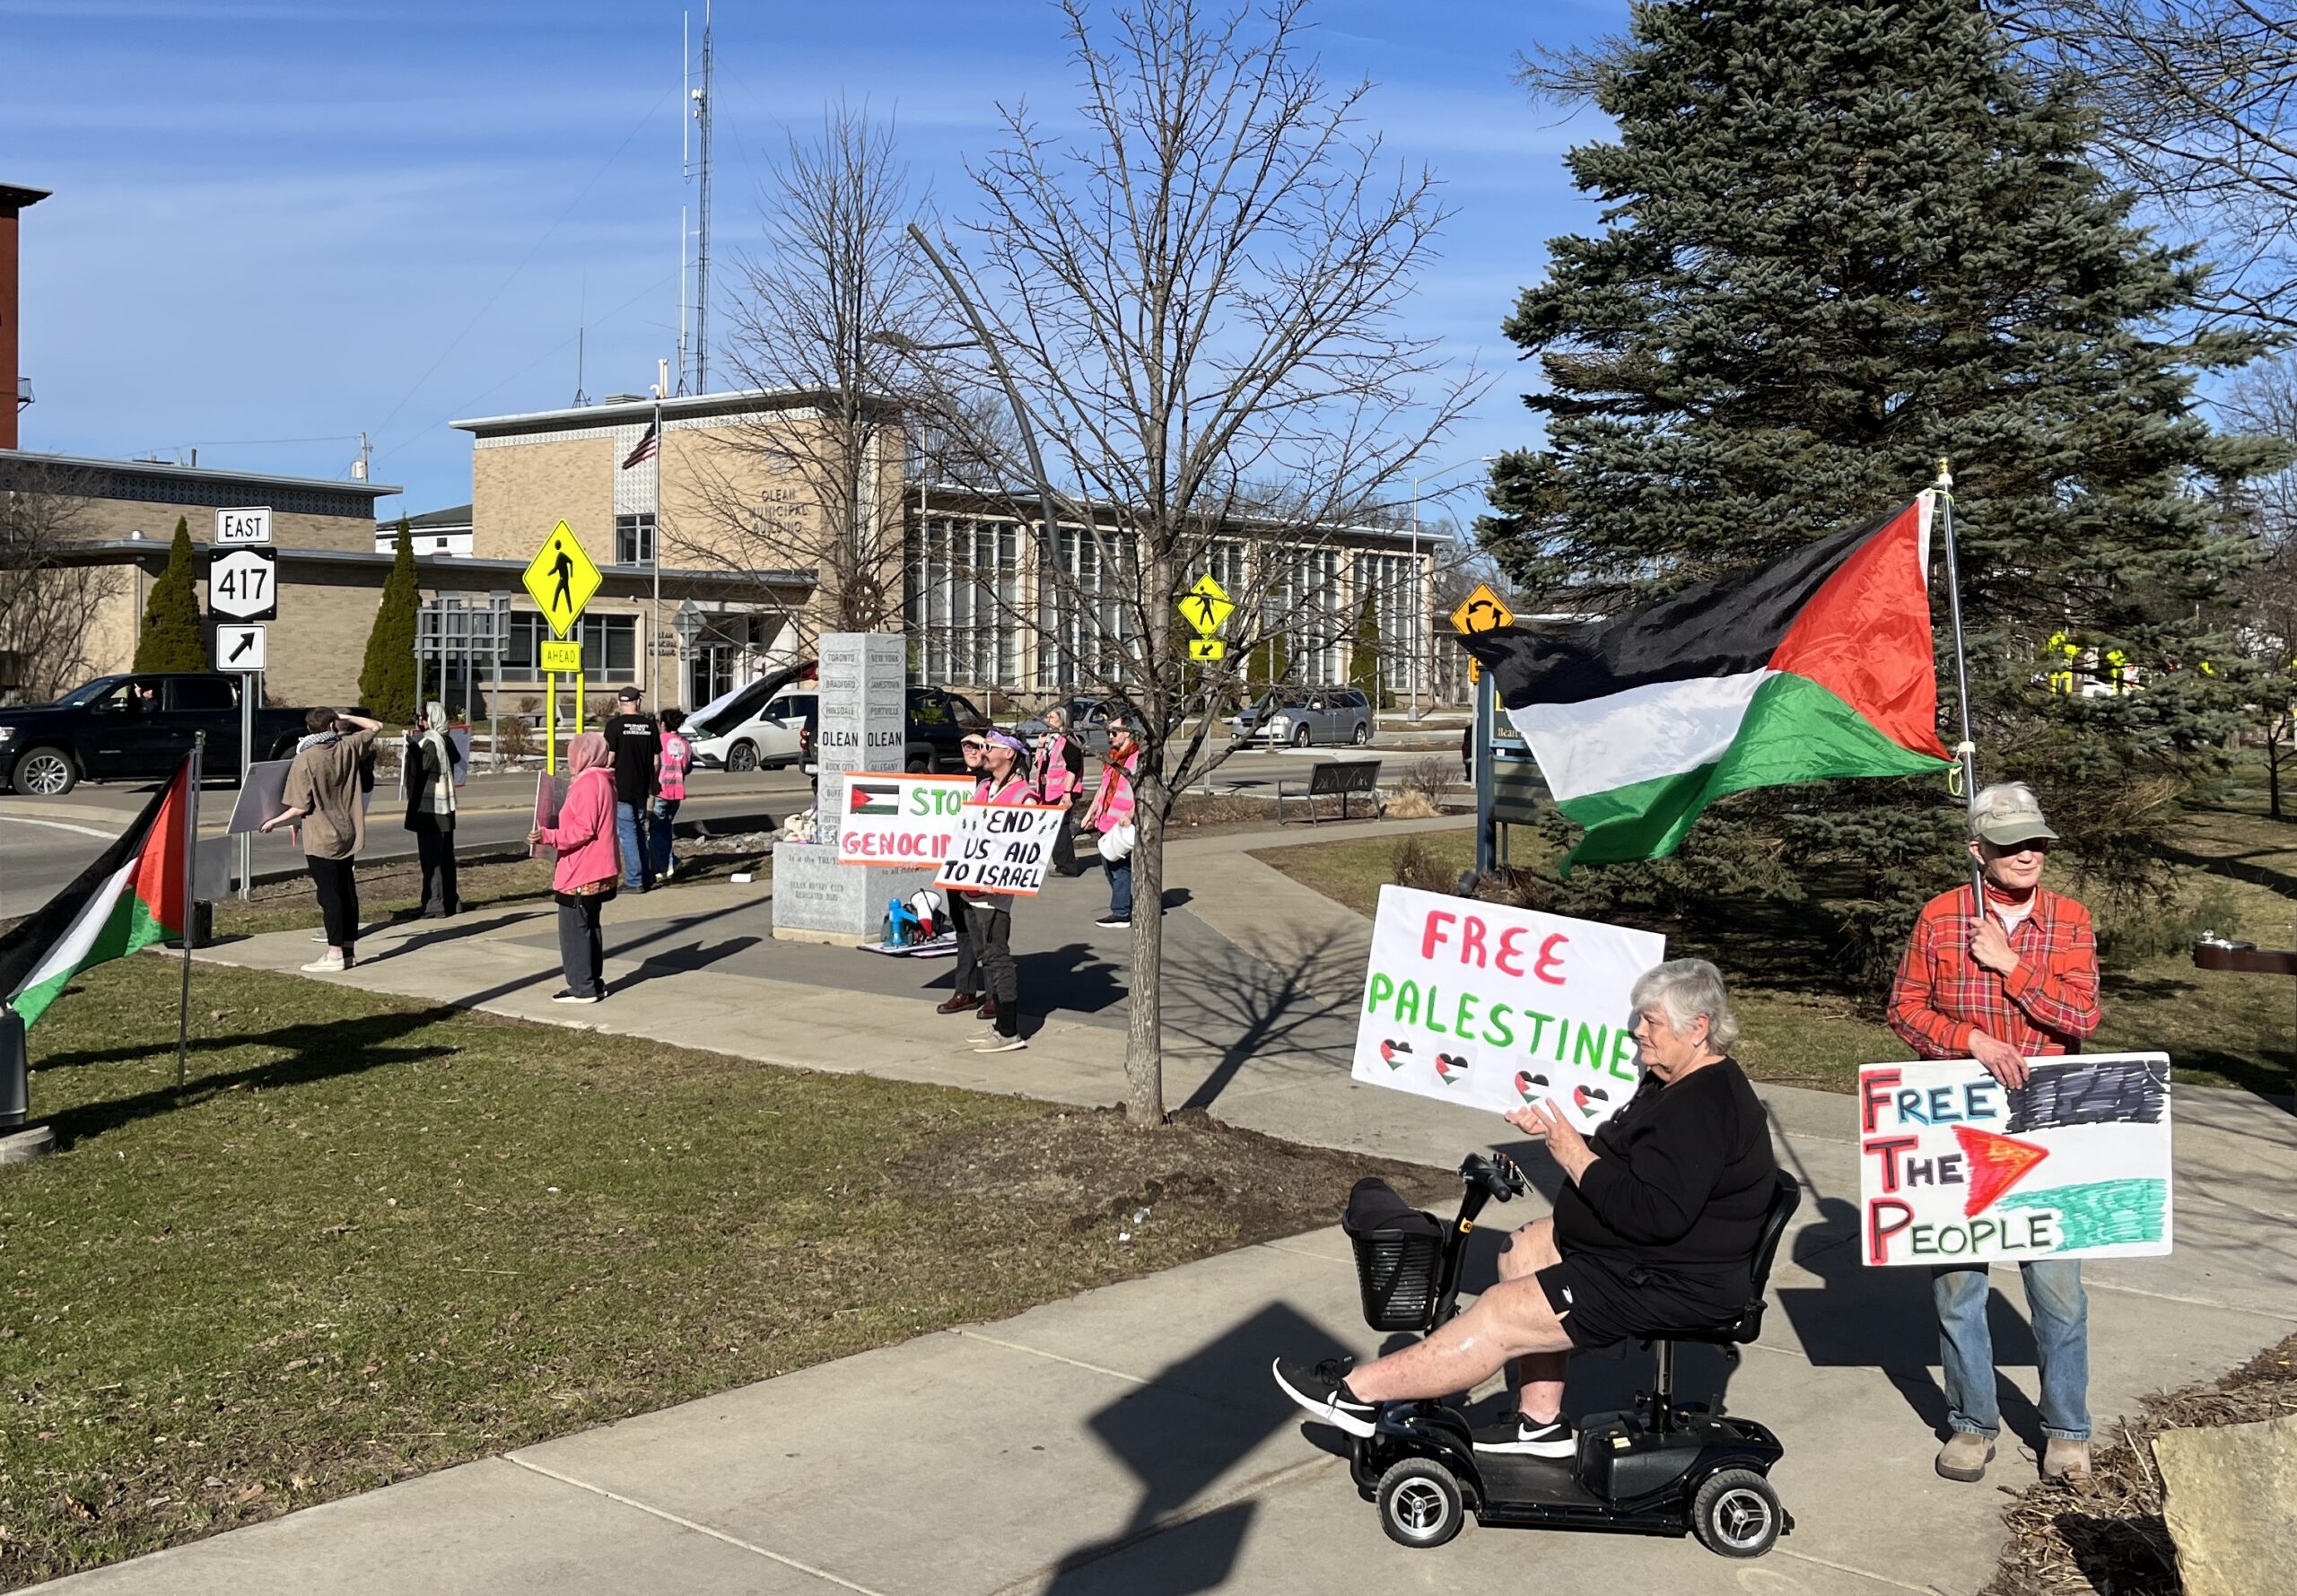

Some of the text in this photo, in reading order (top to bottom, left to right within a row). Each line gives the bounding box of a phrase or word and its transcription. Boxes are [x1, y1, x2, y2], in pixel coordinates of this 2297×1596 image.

[761, 489, 796, 501] OLEAN
[225, 516, 262, 537] EAST
[218, 568, 267, 600] 417
[546, 650, 576, 663] AHEAD
[827, 653, 855, 663] TORONTO
[870, 654, 899, 663] NEW YORK
[825, 680, 855, 689] BRADFORD
[870, 680, 900, 690] JAMESTOWN
[825, 706, 855, 716] HINSDALE
[869, 707, 899, 716] PORTVILLE
[822, 731, 859, 747] OLEAN
[867, 731, 903, 747] OLEAN
[825, 763, 841, 772] ROCK
[842, 763, 854, 772] CITY
[870, 763, 899, 772] ALLEGANY
[987, 810, 1034, 833] END
[964, 838, 1041, 865] US AID
[944, 860, 1039, 887] TO ISRAEL
[1421, 910, 1570, 985] FREE
[1367, 972, 1636, 1082] PALESTINE
[1860, 1068, 1998, 1133] FREE
[1863, 1135, 1965, 1193] THE
[1868, 1198, 2053, 1265] PEOPLE
